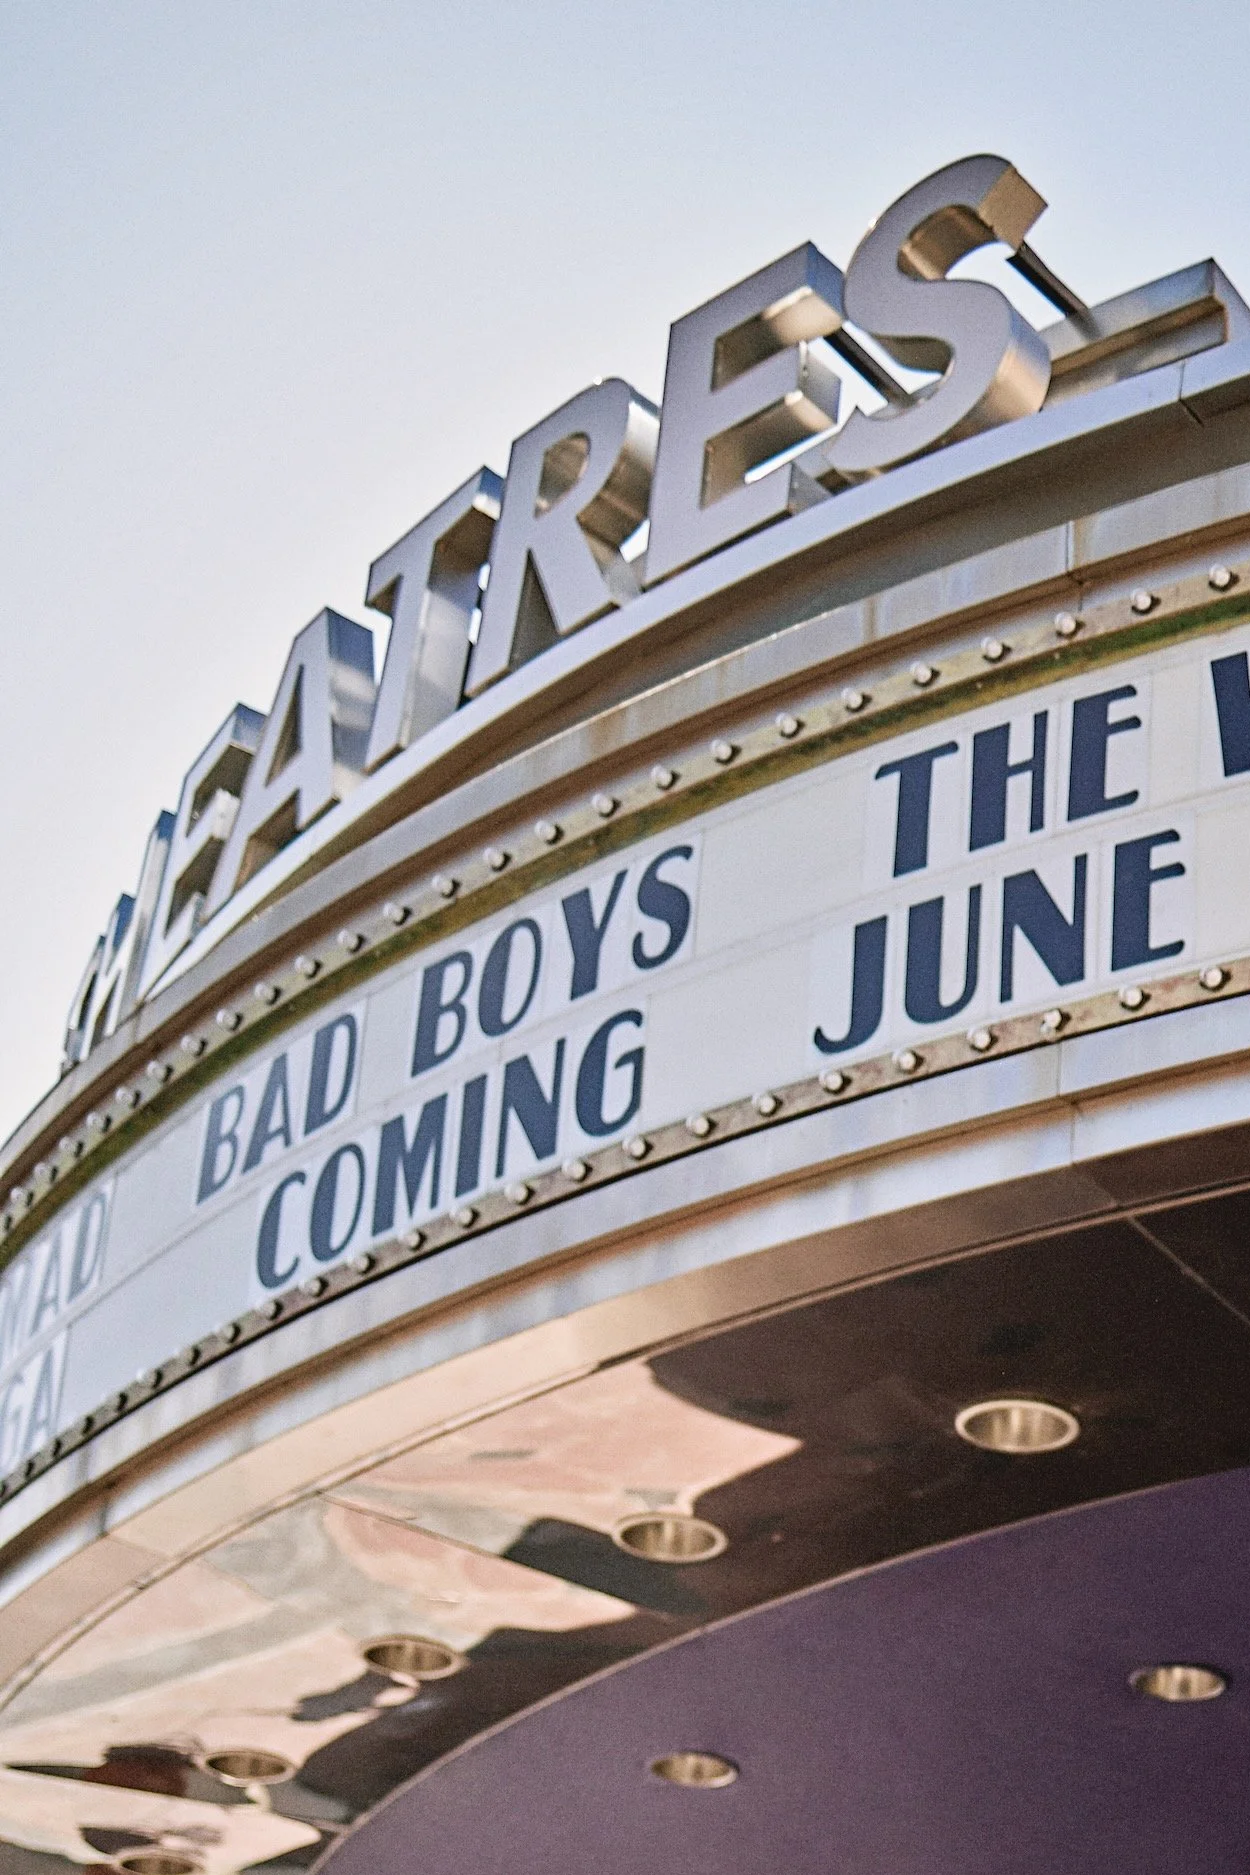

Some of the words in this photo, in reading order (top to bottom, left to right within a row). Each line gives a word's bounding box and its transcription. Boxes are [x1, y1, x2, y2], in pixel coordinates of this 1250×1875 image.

[875, 685, 1142, 878] THE
[197, 1013, 357, 1205] BAD
[411, 845, 694, 1077] BOYS
[257, 1009, 646, 1289] COMING
[814, 829, 1187, 1055] JUNE
[0, 1193, 107, 1364] MAD
